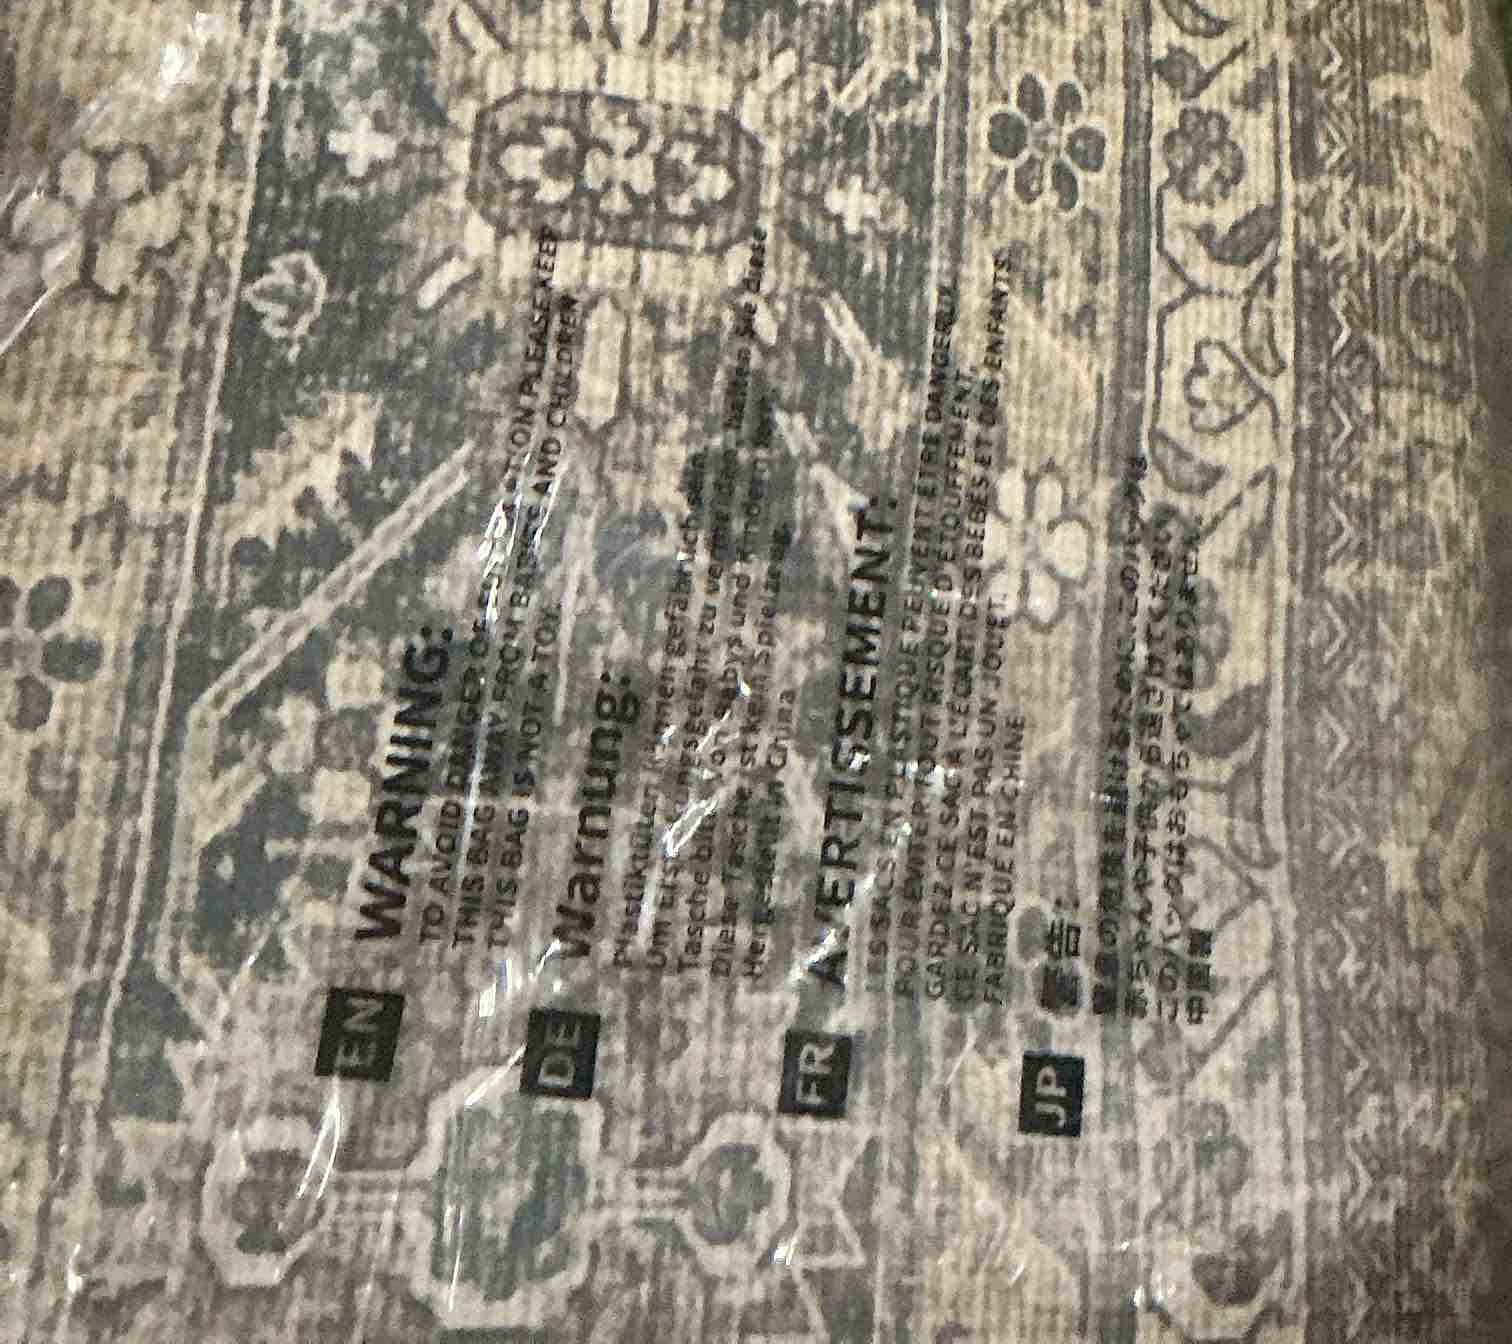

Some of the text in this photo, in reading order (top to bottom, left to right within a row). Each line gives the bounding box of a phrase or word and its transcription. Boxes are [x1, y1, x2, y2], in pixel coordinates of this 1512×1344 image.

[976, 698, 998, 738] UN
[997, 712, 1027, 801] CHINE
[355, 624, 452, 947] WARNING:
[499, 805, 530, 868] BAG
[516, 700, 545, 762] NOT
[970, 747, 993, 798] PAS
[427, 798, 463, 895] AVOID
[465, 802, 496, 866] BAG
[548, 670, 640, 963] Warnung:
[993, 811, 1017, 848] EN
[418, 898, 447, 946] TO
[451, 871, 485, 951] THIS
[922, 880, 955, 999] GARDEZ
[892, 910, 923, 997] POUR
[332, 995, 382, 1072] EN
[533, 1019, 585, 1091] DE
[800, 1040, 836, 1111] FR
[1033, 1063, 1069, 1132] JP
